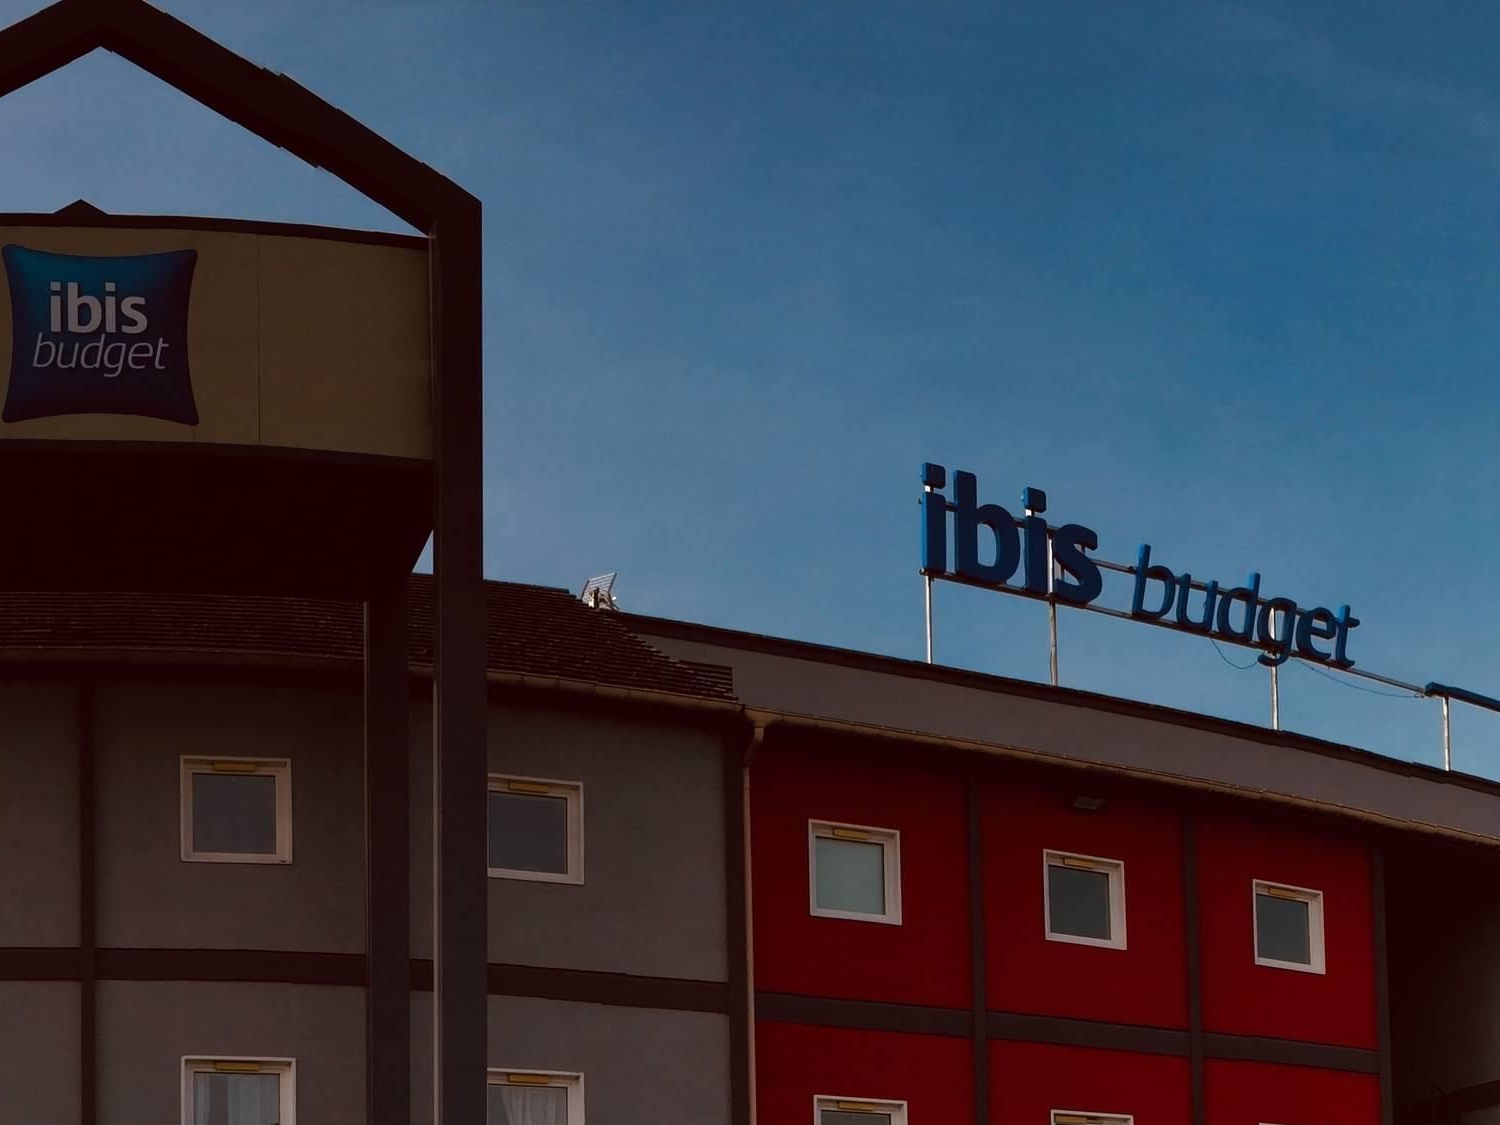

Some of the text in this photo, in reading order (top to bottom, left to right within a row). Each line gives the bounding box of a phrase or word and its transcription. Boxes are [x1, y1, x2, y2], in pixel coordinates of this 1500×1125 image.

[49, 280, 149, 334] ibis
[32, 331, 170, 379] budget
[920, 461, 1361, 669] ibis budget
